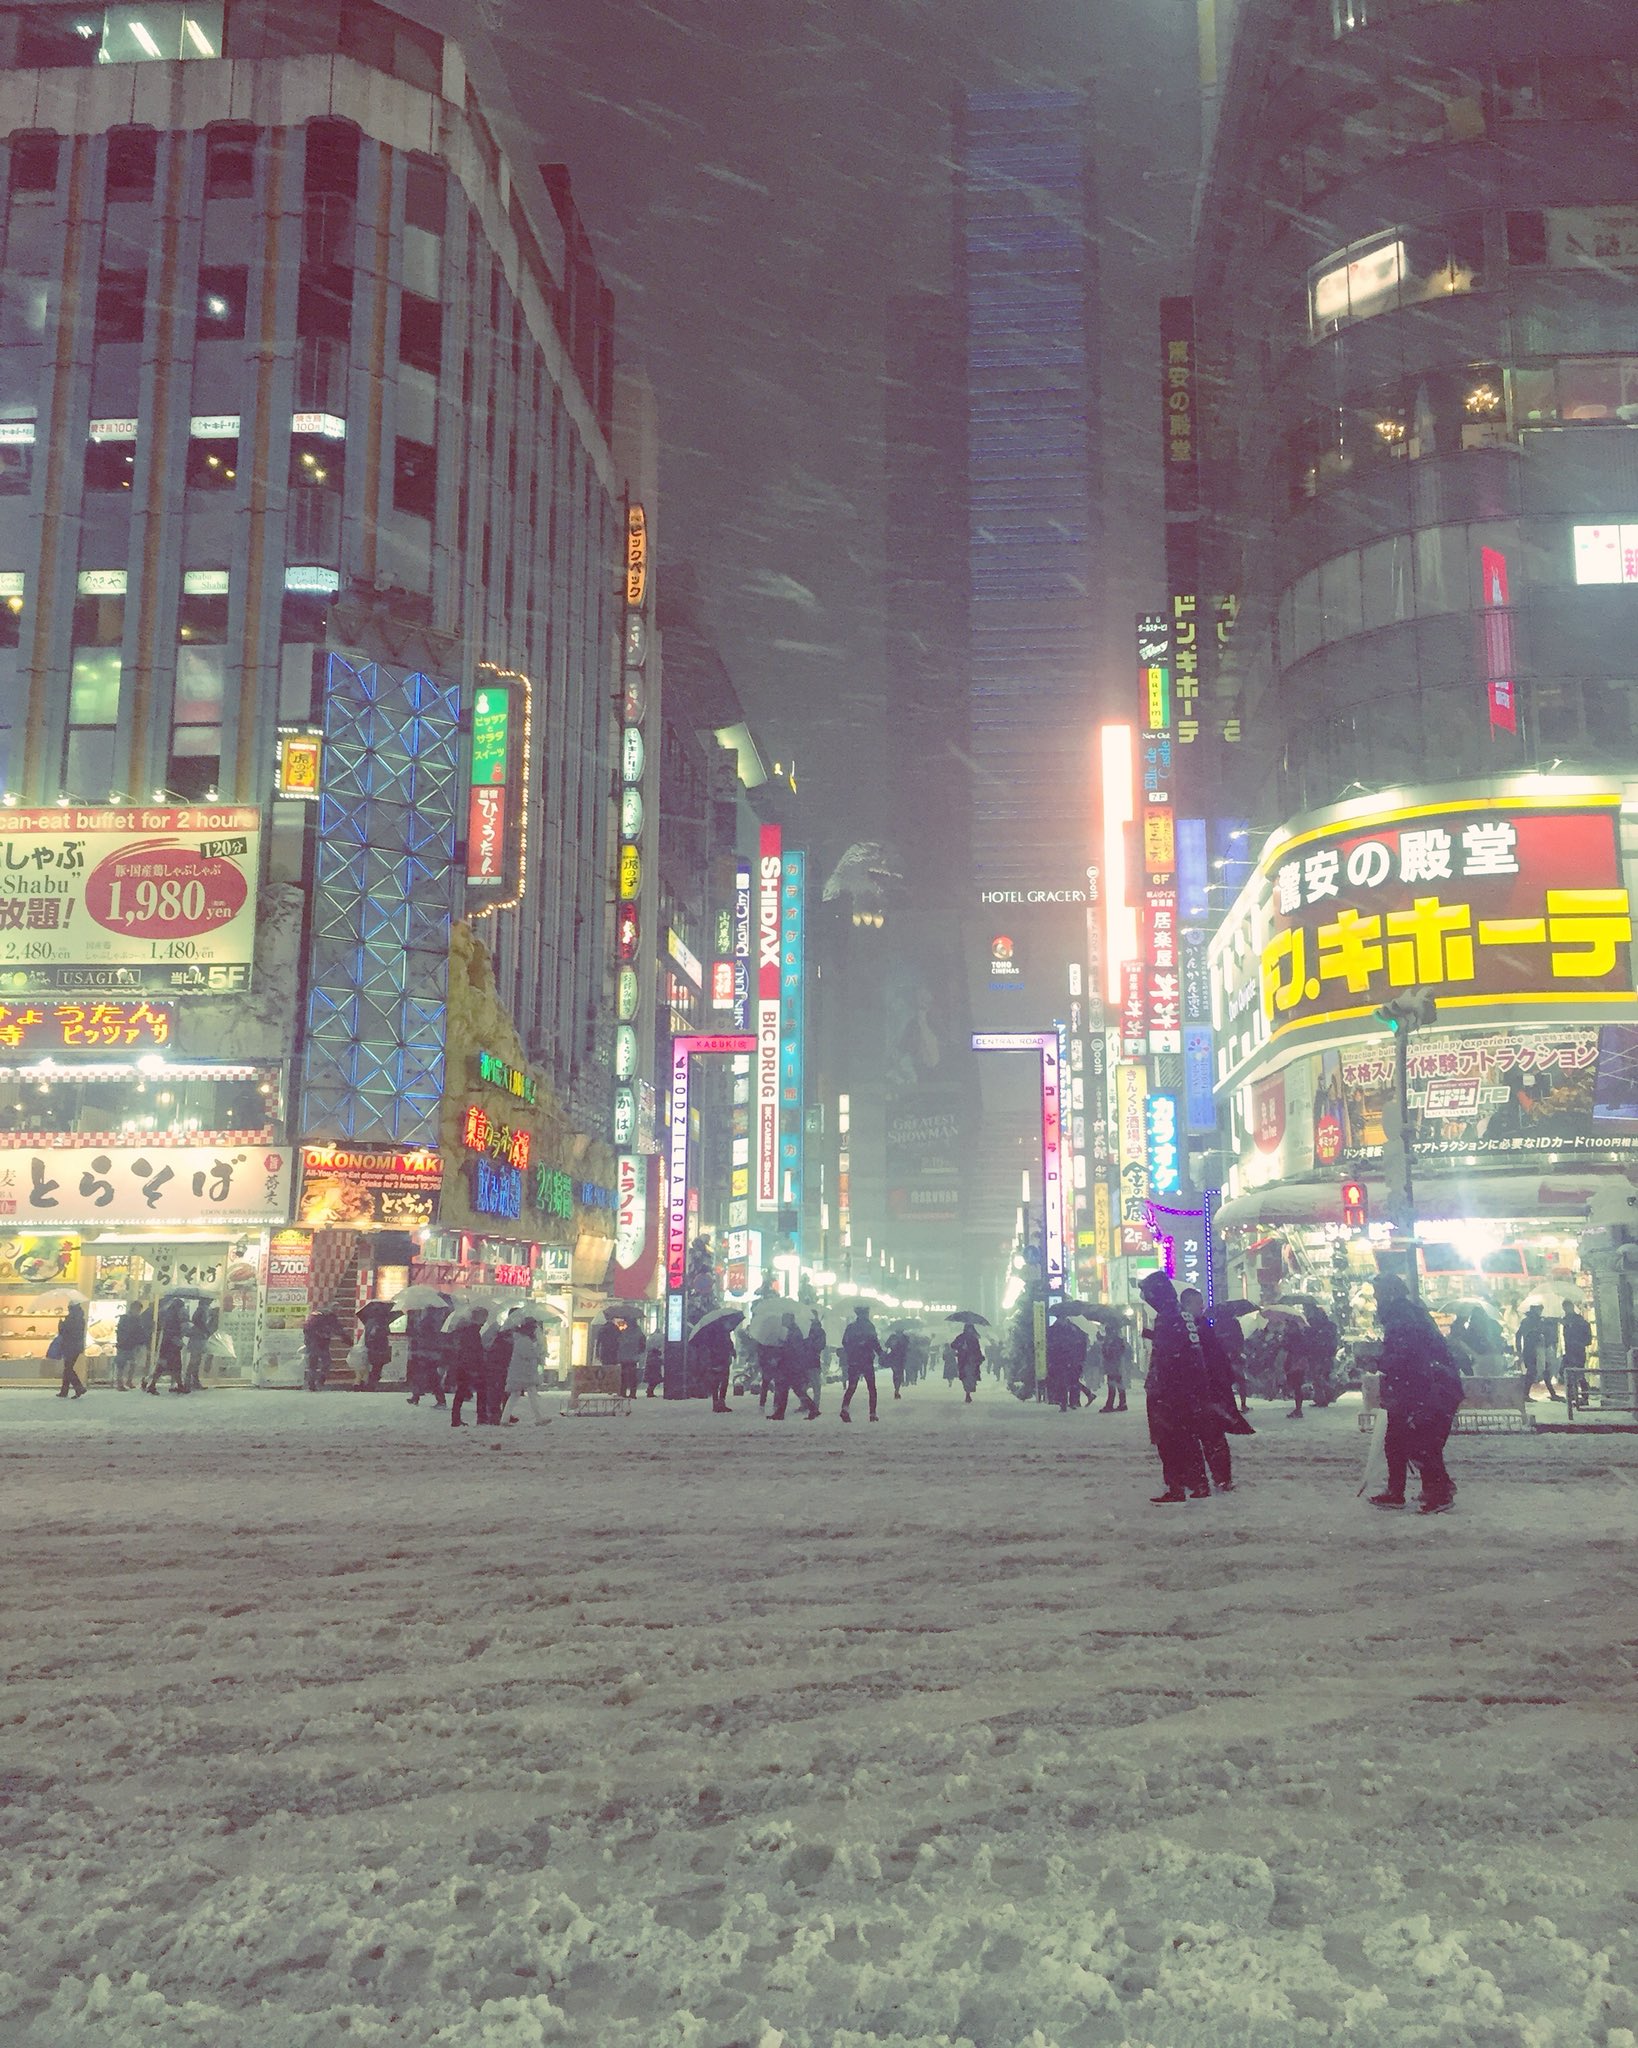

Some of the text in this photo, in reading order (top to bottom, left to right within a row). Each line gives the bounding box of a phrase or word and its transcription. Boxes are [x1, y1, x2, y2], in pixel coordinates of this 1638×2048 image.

[76, 811, 135, 829] buffet
[142, 811, 171, 829] for
[176, 812, 191, 829] 2
[478, 799, 499, 875] ひょうたん
[204, 840, 244, 858] 120分
[1278, 821, 1520, 915] 驚安の殿堂
[1152, 874, 1170, 885] 6F
[105, 879, 232, 927] 1,980 yen
[982, 890, 1087, 904] HOTEL GRACERY
[760, 856, 781, 968] SHIDAX
[1153, 911, 1174, 968] 居楽屋
[52, 951, 71, 960] yen
[195, 951, 214, 960] yen
[991, 961, 1013, 969] TOHO
[207, 966, 245, 989] 5F
[1020, 1037, 1044, 1045] ROAD
[1422, 1041, 1441, 1051] real
[1443, 1041, 1462, 1053] spy
[1464, 1036, 1524, 1048] experience
[761, 1011, 777, 1098] BIC DRUG
[1343, 1046, 1599, 1084] 本格スイ体験アトラクション
[1151, 1096, 1179, 1191] カラオケ
[306, 1151, 444, 1172] OKONOMI YAKI
[671, 1072, 687, 1252] GODZILLA ROAD
[28, 1154, 247, 1210] とらそば
[360, 1180, 382, 1188] Drinks
[383, 1181, 393, 1189] for
[399, 1181, 419, 1190] hours
[361, 1172, 384, 1181] dinner
[384, 1173, 399, 1181] with
[619, 1161, 636, 1226] トラノコ
[1123, 1227, 1143, 1243] 2F
